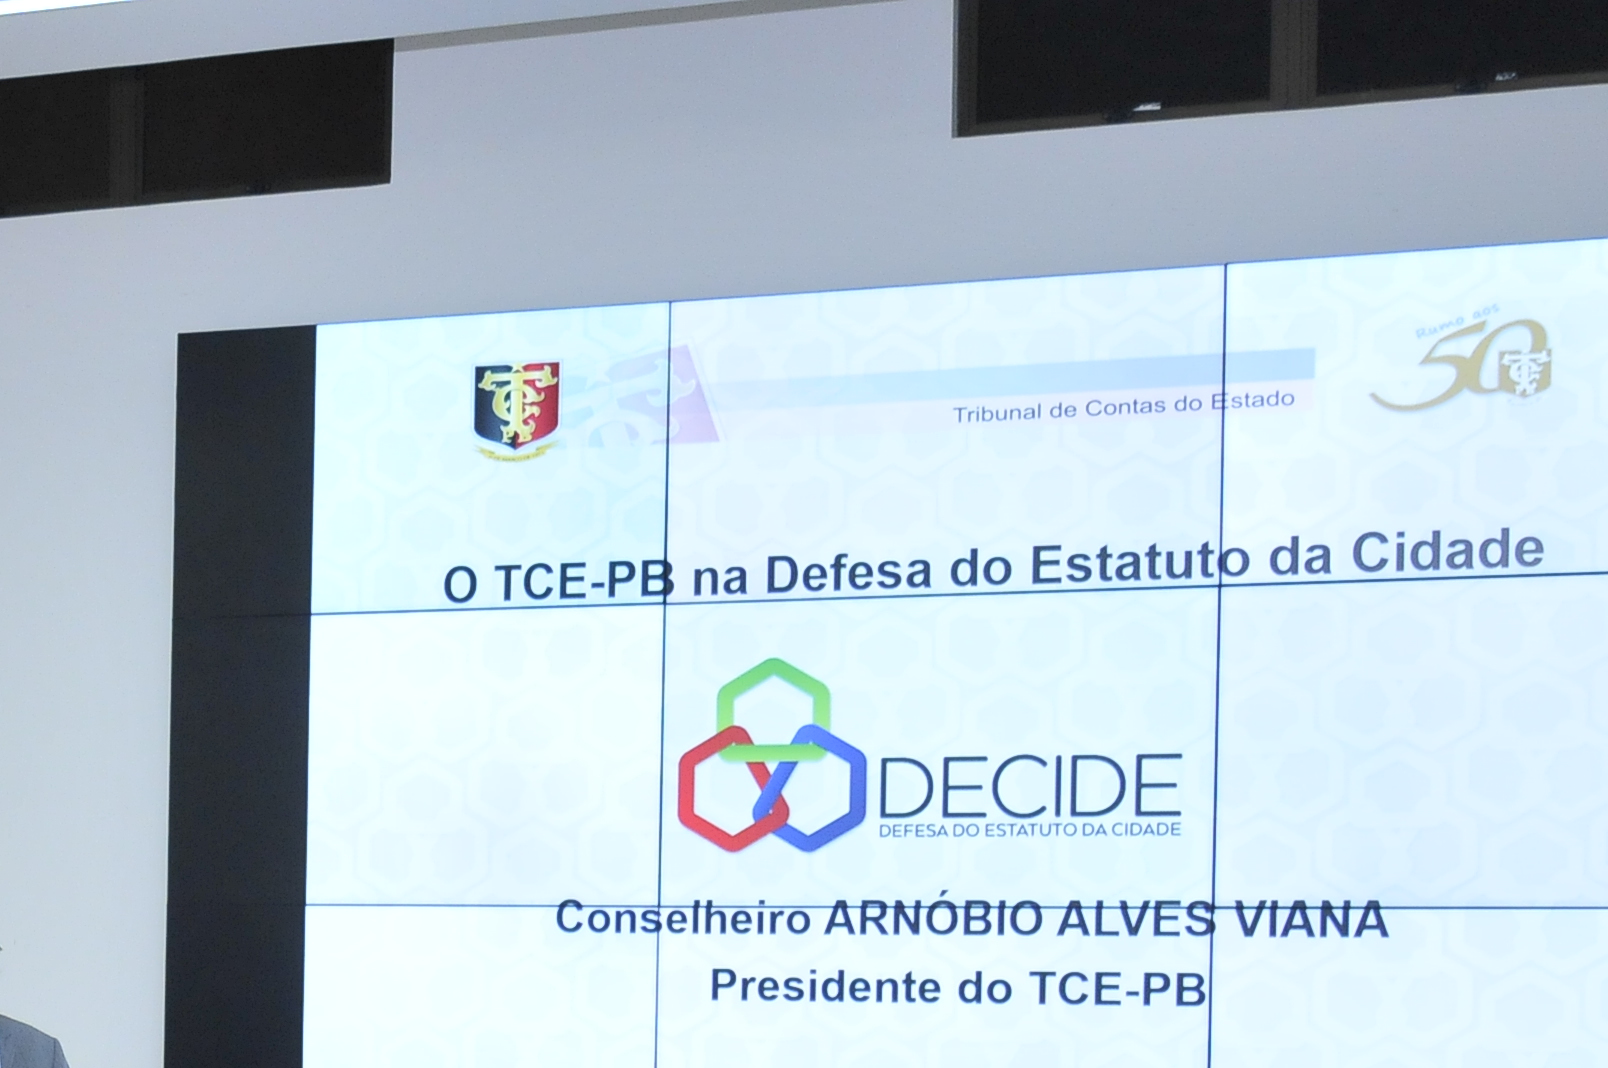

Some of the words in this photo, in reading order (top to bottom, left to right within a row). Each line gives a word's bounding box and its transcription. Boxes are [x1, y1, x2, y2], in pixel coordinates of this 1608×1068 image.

[1415, 315, 1465, 340] Rumo
[1472, 302, 1501, 320] aos
[953, 402, 1042, 424] Tribunal
[1049, 401, 1078, 418] de
[1085, 397, 1166, 417] Contas
[1174, 395, 1203, 412] do
[1210, 389, 1296, 411] Estado
[443, 564, 478, 604] O
[494, 559, 675, 602] TCE-PB
[693, 565, 748, 597] na
[766, 553, 932, 595] Defesa
[950, 548, 1013, 588] do
[1031, 540, 1251, 586] Estatuto
[1269, 535, 1332, 577] da
[1352, 527, 1545, 574] Cidade
[880, 753, 1183, 819] DECIDE
[878, 823, 949, 838] DEFESA
[952, 823, 980, 838] DO
[984, 822, 1078, 837] ESTATUTO
[1081, 822, 1108, 837] DA
[1111, 821, 1182, 837] CIDADE
[555, 898, 811, 935] Conselheiro
[823, 889, 1044, 937] ARNÓBIO
[1056, 899, 1216, 937] ALVES
[1234, 899, 1390, 938] VIANA
[711, 967, 942, 1003] Presidente
[957, 970, 1013, 1005] do
[1028, 970, 1207, 1007] TCE-PB
